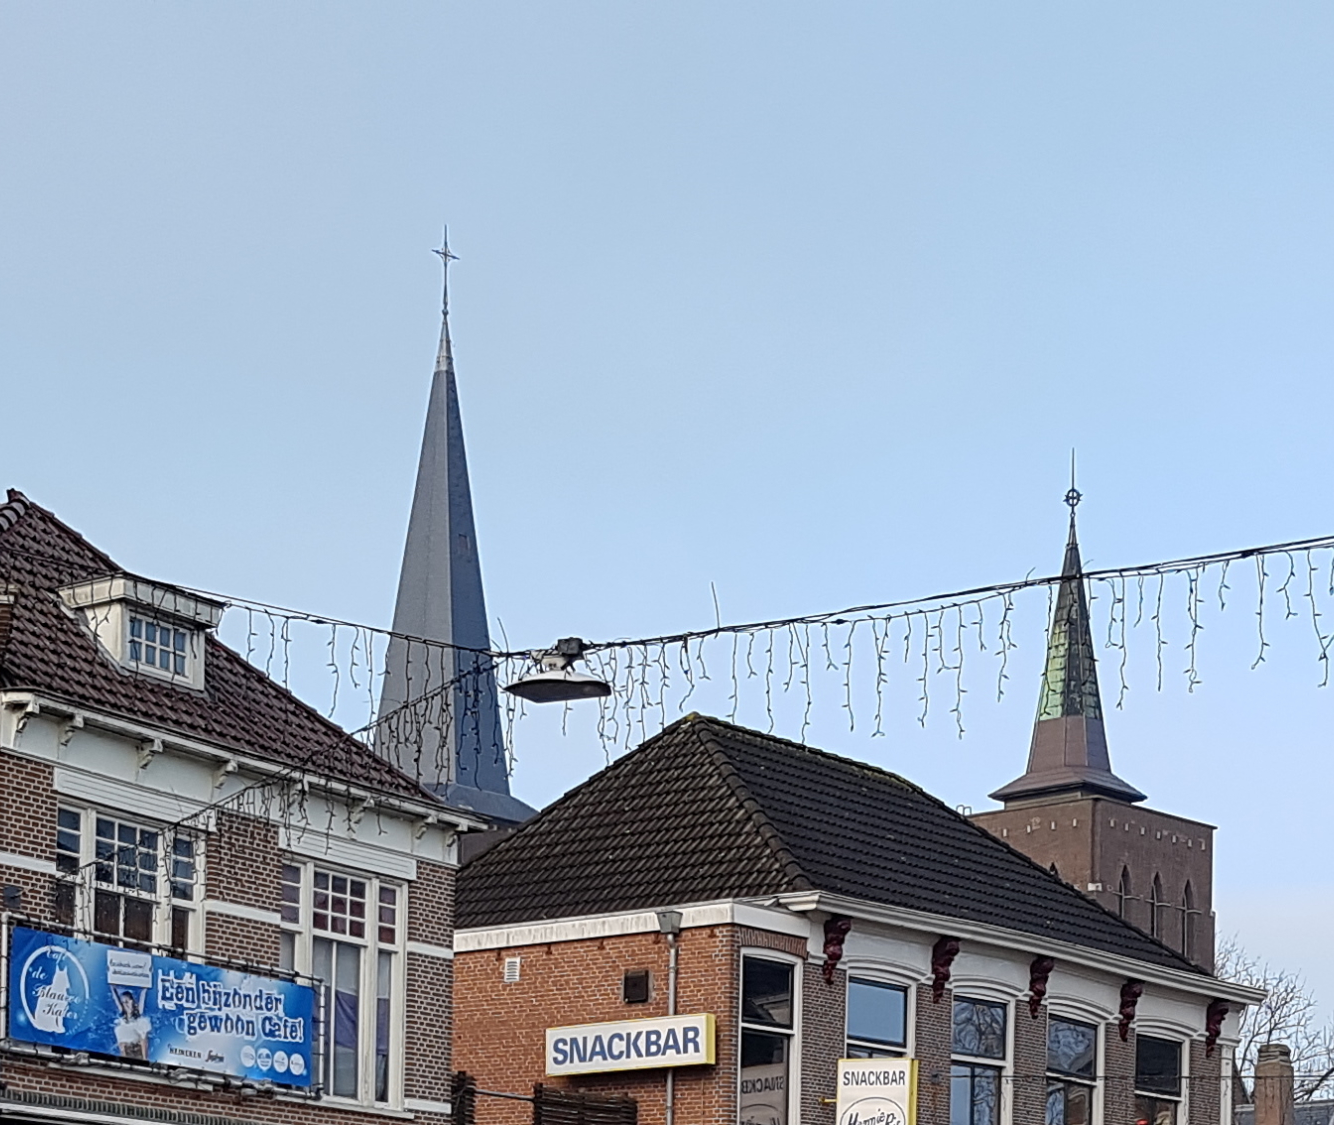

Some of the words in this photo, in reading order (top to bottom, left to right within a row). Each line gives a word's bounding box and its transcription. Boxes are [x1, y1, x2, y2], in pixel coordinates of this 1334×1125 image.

[31, 966, 47, 980] de
[160, 976, 197, 1006] Een
[200, 982, 283, 1013] bijzonder
[185, 1011, 256, 1037] gewoon
[552, 1025, 701, 1066] SNACKBAR
[842, 1070, 906, 1087] SNACKBAR
